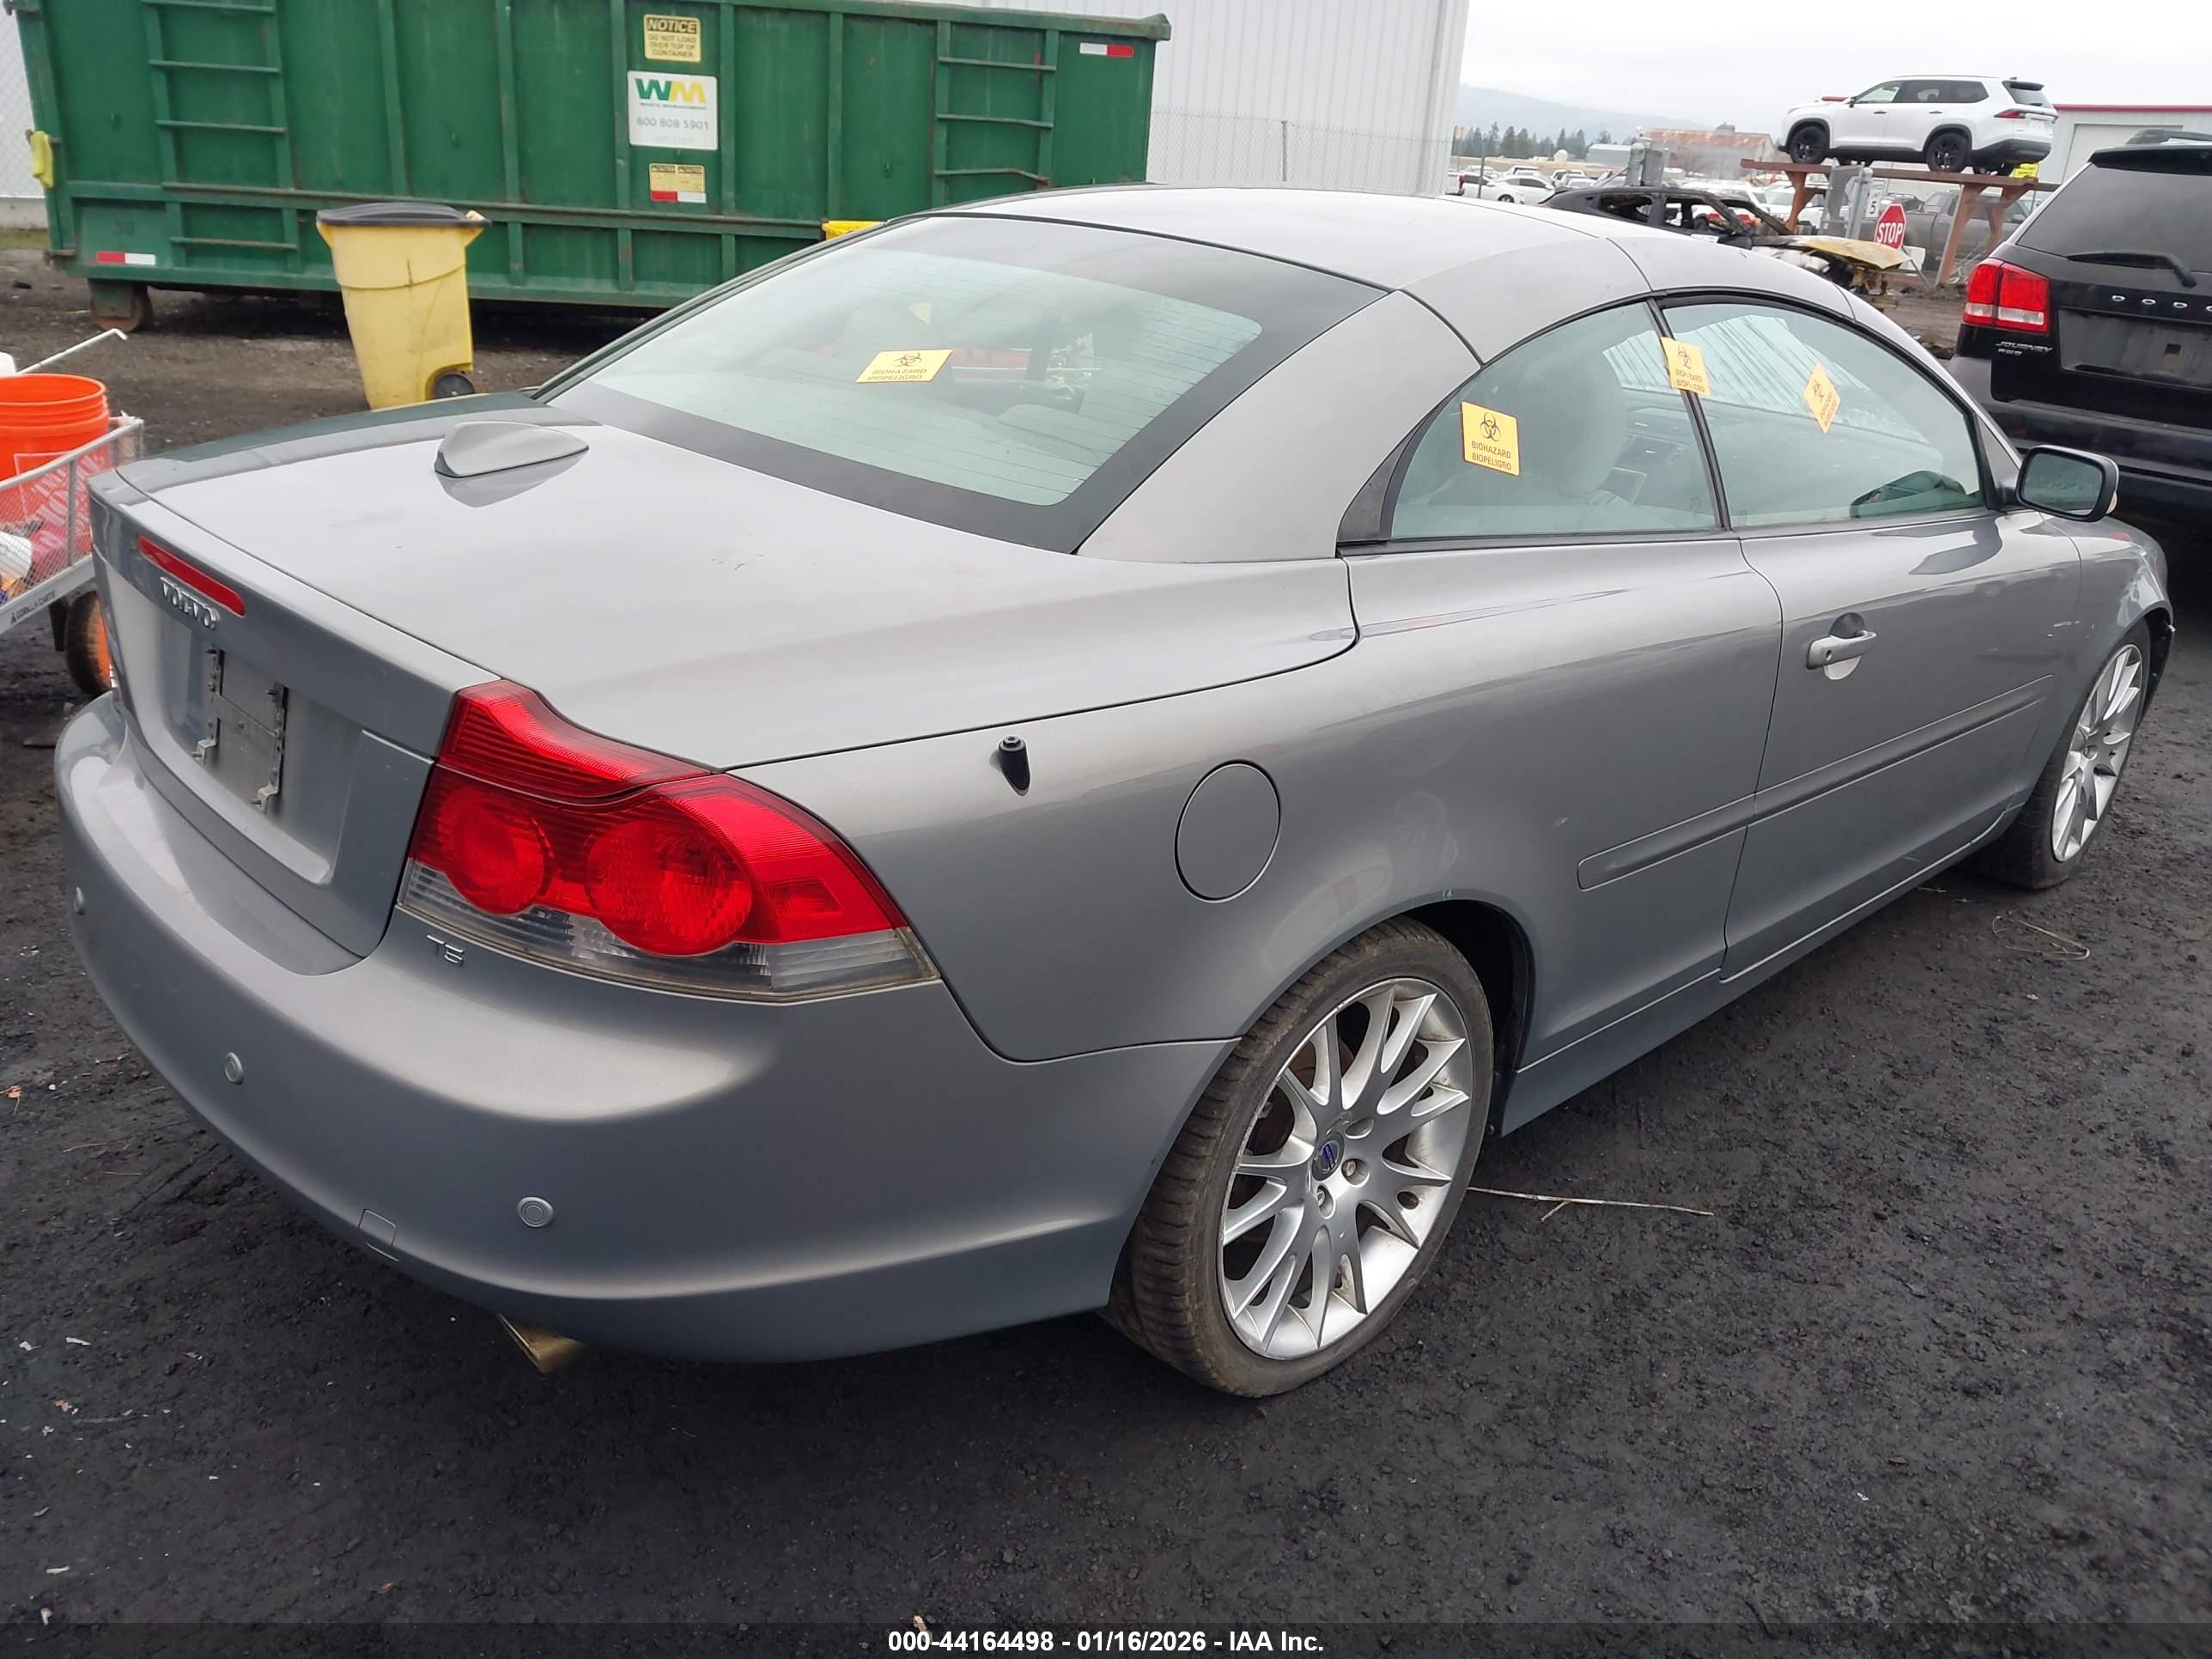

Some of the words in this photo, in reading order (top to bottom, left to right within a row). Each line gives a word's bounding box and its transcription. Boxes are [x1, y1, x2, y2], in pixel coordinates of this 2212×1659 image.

[648, 19, 696, 33] NOTICE
[635, 78, 707, 105] WM
[636, 117, 657, 127] 800
[659, 118, 680, 129] 808
[684, 120, 708, 131] 5901
[1876, 222, 1904, 244] STOP
[1996, 341, 2052, 353] JOURNEY
[1471, 440, 1512, 459] BIOHAZARD
[1472, 452, 1512, 471] BIOPELIGRO
[160, 576, 221, 629] VOLVO
[426, 934, 465, 967] T5
